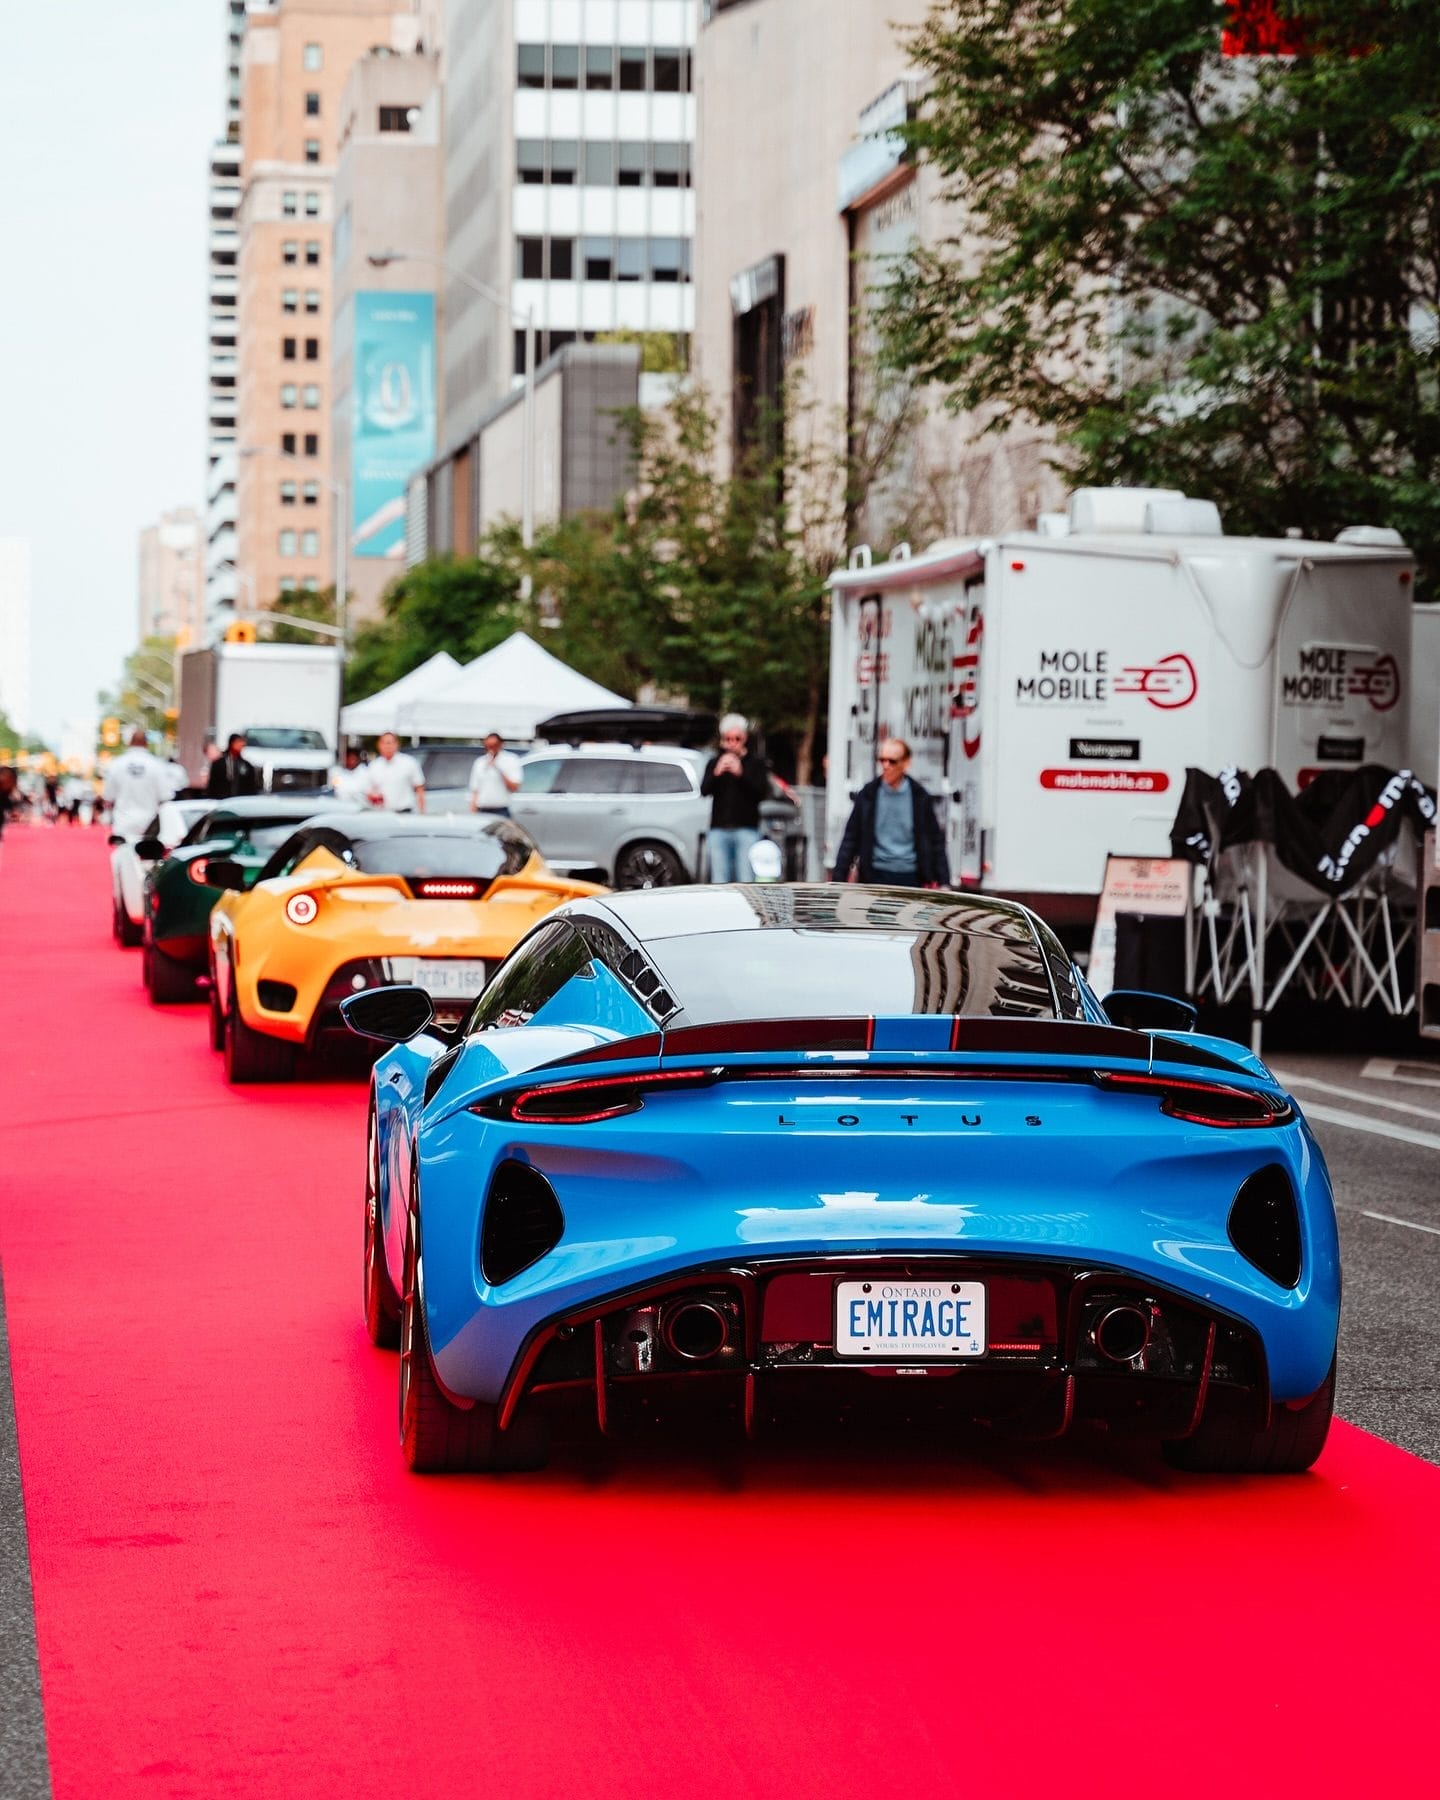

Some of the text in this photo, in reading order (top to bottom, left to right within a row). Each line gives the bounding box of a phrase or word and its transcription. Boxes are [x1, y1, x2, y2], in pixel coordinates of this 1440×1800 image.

[1040, 651, 1108, 673] MOLE
[1300, 650, 1347, 674] MOLE
[1016, 677, 1108, 701] MOBILE
[1283, 677, 1346, 701] MOBILE
[1054, 771, 1155, 790] molemobile.ca
[778, 1114, 1043, 1127] LOTUS
[850, 1300, 971, 1337] EMIRAGE
